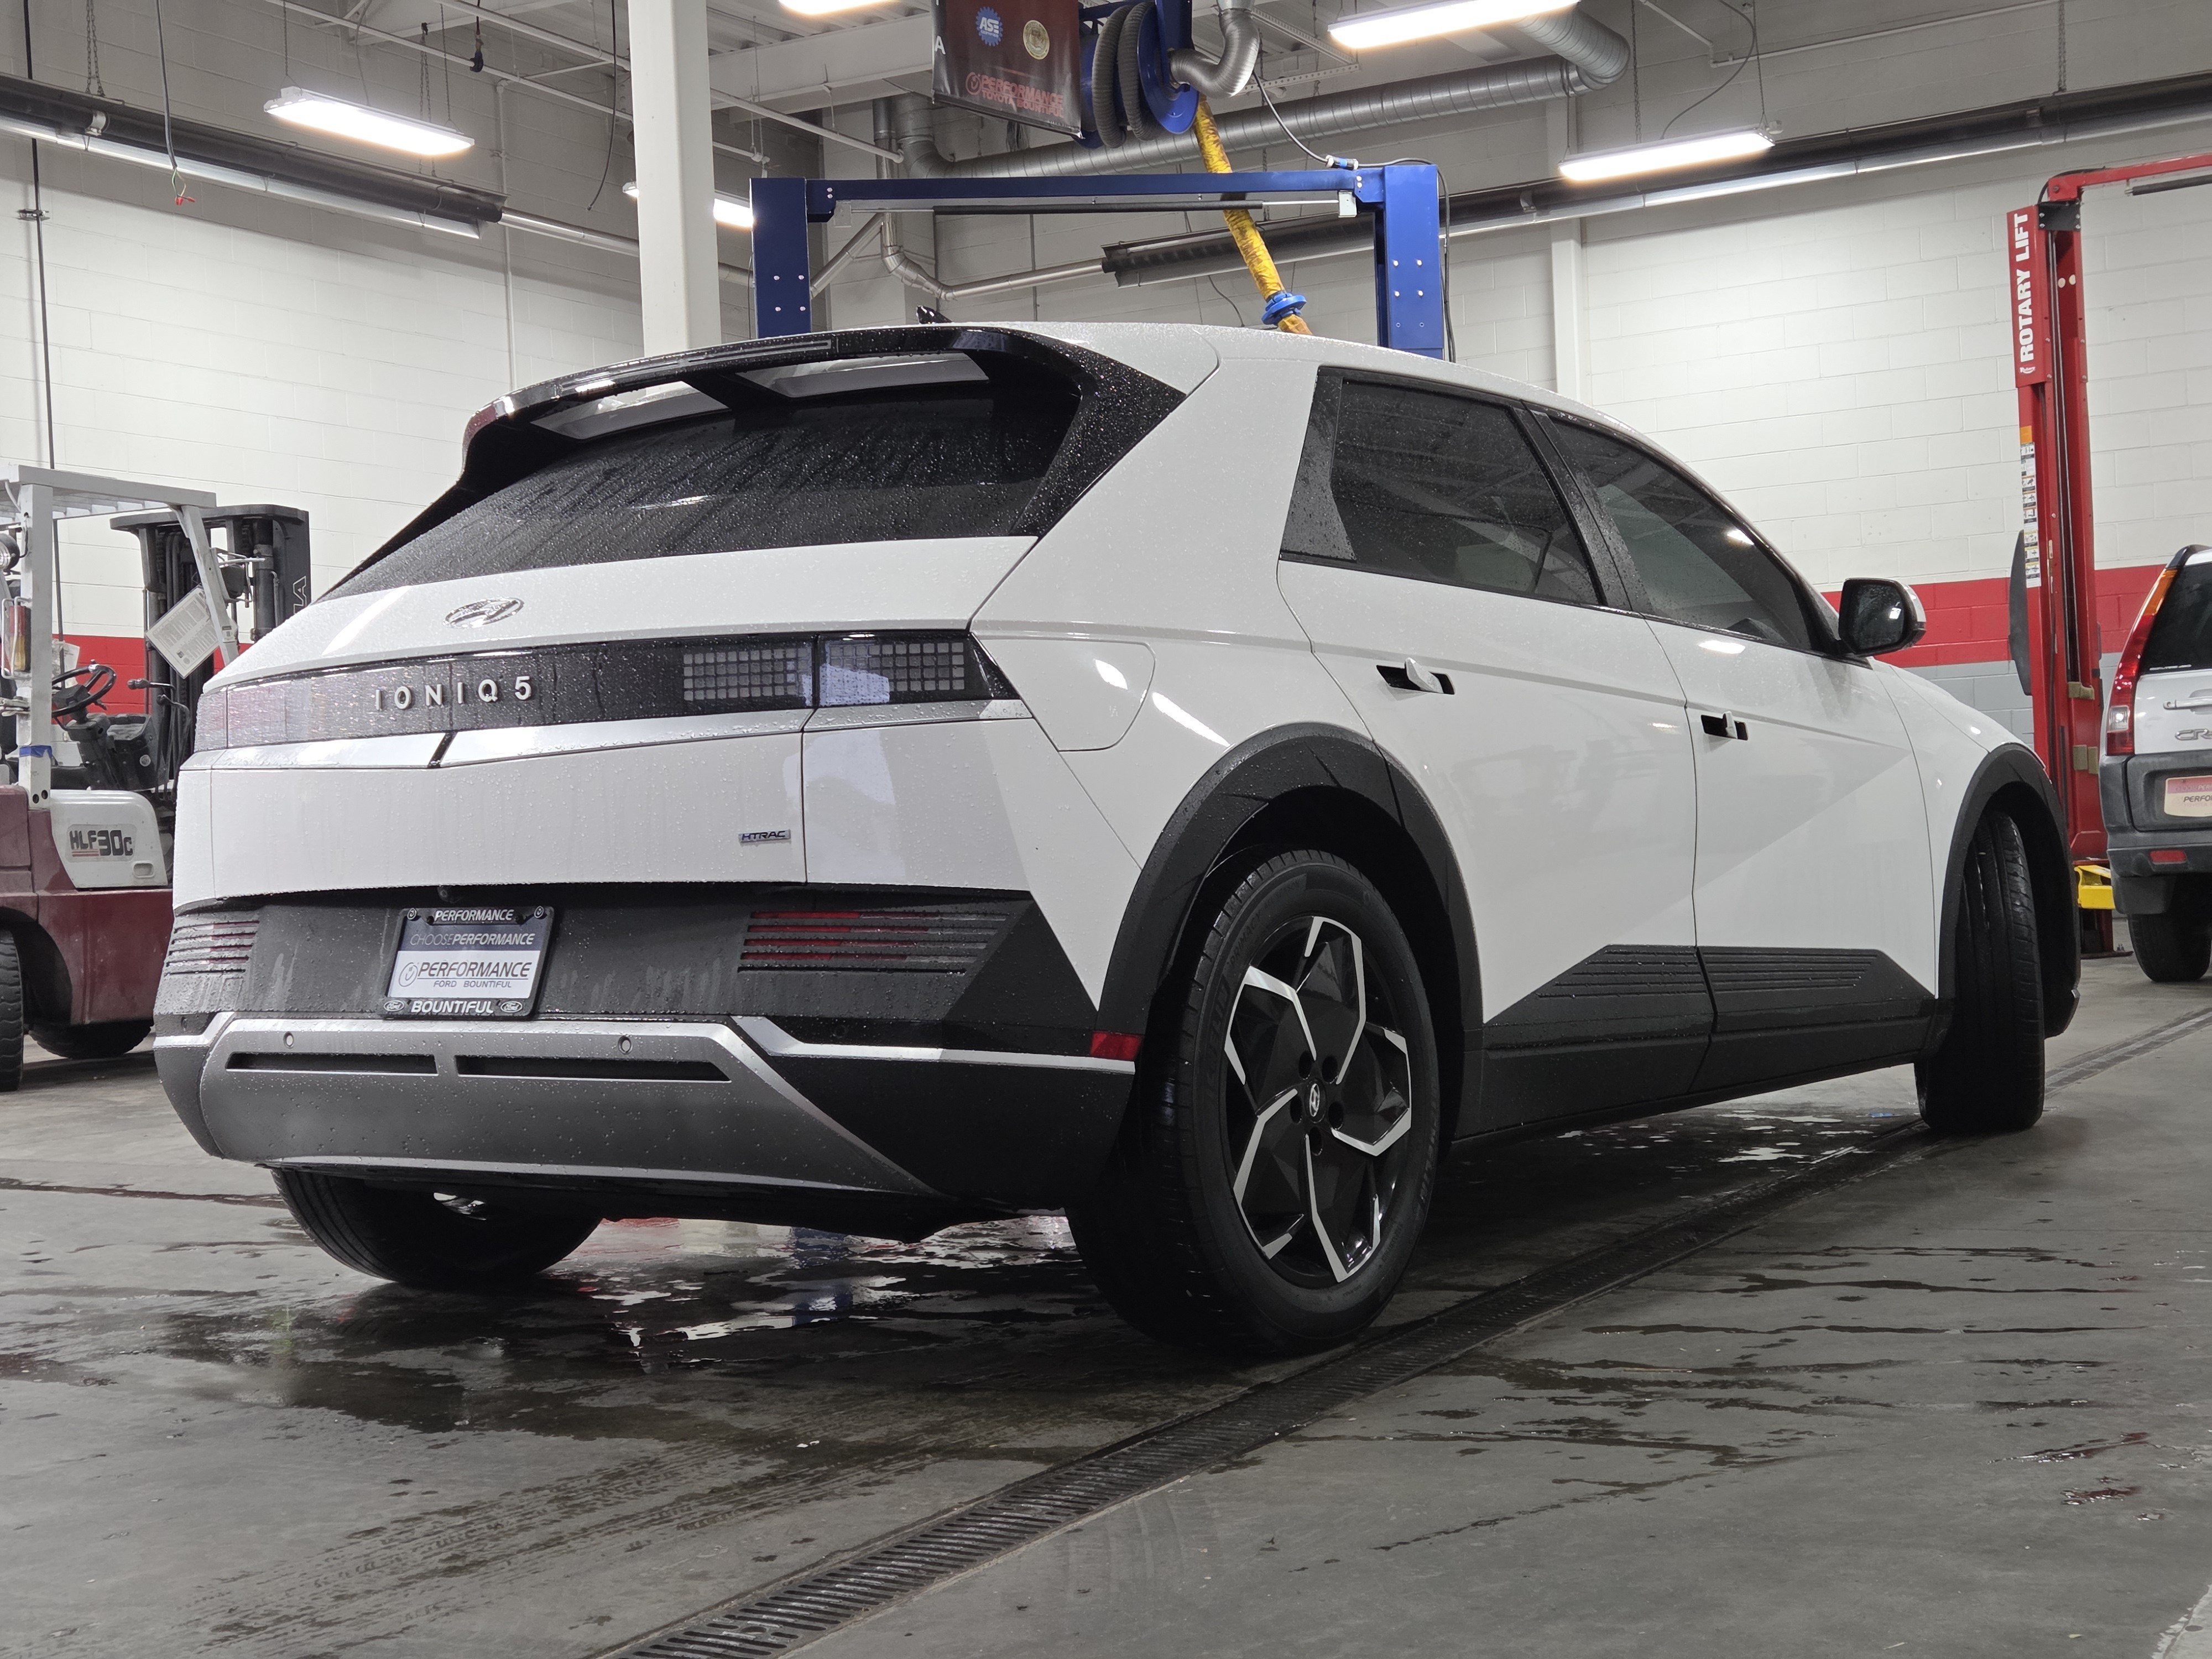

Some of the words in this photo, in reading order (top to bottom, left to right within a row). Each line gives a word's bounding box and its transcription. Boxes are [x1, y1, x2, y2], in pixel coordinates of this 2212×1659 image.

[979, 17, 999, 34] ASE
[982, 75, 1063, 106] PERFORMANCE
[982, 90, 1014, 105] TOYOTA
[2014, 213, 2030, 262] LIFT
[2016, 269, 2034, 362] ROTARY
[375, 679, 498, 711] IONIQ
[514, 676, 532, 700] 5
[742, 831, 785, 840] HTRAC
[435, 909, 514, 921] PERFORMANCE
[418, 962, 533, 977] PERFORMANCE
[411, 1000, 494, 1013] BOUNTIFUL
